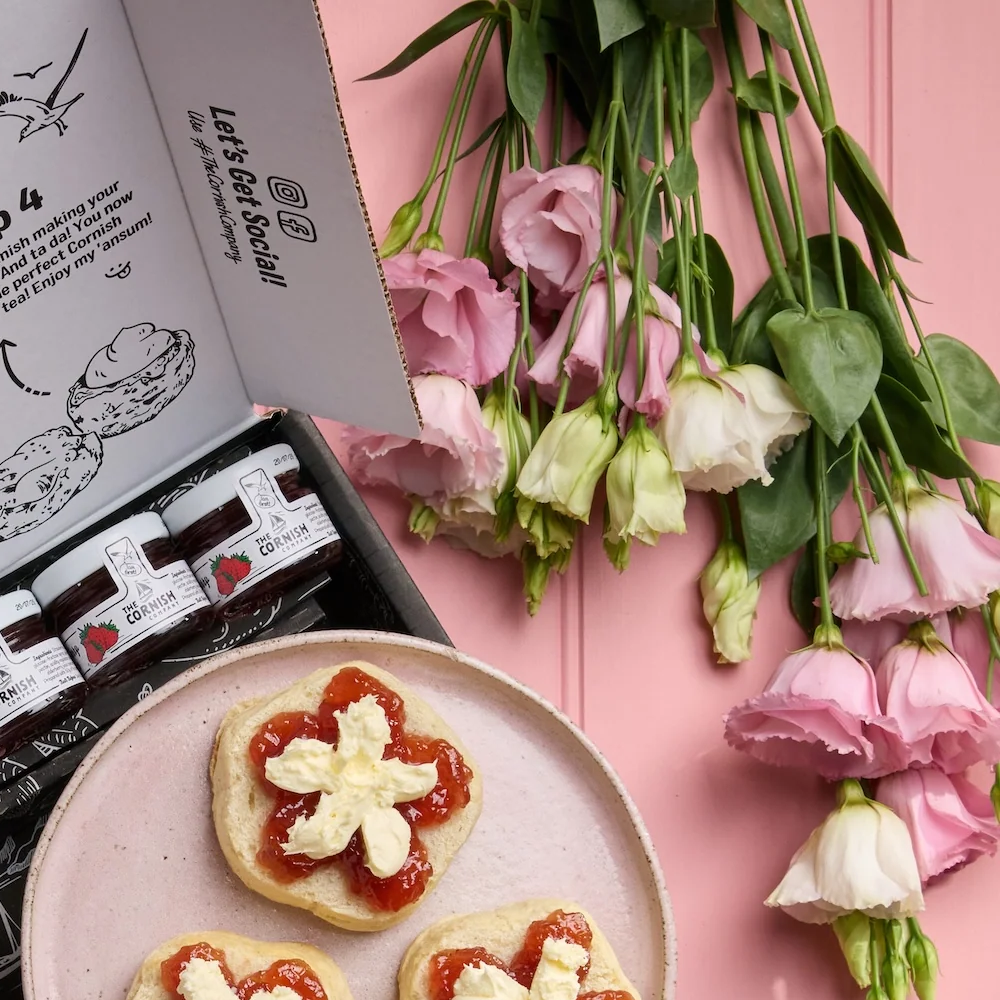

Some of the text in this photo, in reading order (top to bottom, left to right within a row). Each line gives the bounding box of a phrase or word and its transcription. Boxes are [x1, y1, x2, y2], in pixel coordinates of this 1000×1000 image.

[20, 187, 43, 212] 4
[32, 203, 86, 241] making
[87, 181, 119, 209] your
[187, 111, 242, 264] Use #TheCornishCompany
[209, 106, 287, 288] Let's Get Social!
[1, 254, 28, 279] And
[30, 246, 47, 260] ta
[49, 227, 72, 248] da!
[72, 211, 102, 232] You
[104, 191, 132, 215] now
[2, 288, 30, 312] tea!
[31, 264, 70, 294] Enjoy
[74, 250, 94, 269] my
[97, 212, 152, 251] 'ansum!
[12, 250, 66, 291] perfect
[68, 216, 122, 254] Cornish
[256, 532, 272, 545] THE
[259, 524, 309, 556] CORNISH
[122, 601, 138, 614] THE
[126, 590, 176, 625] CORNISH
